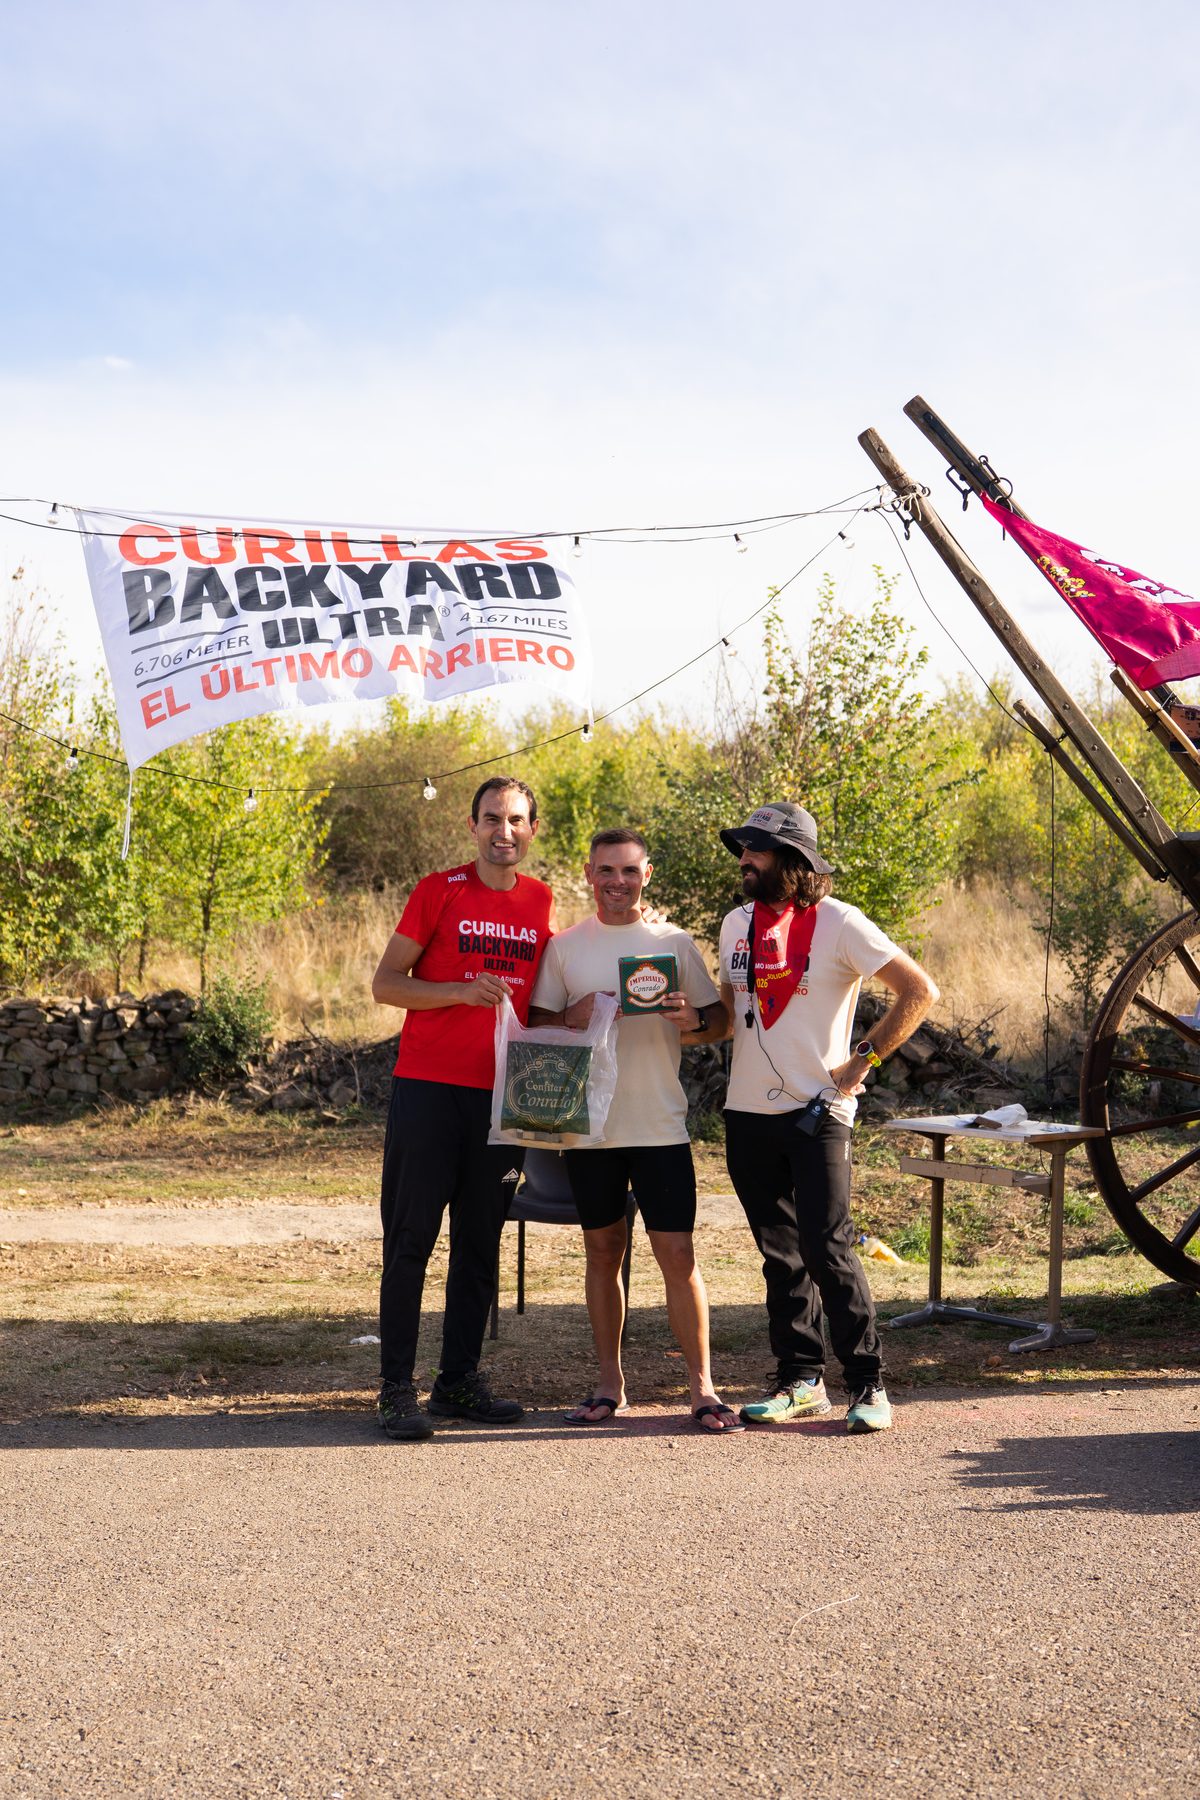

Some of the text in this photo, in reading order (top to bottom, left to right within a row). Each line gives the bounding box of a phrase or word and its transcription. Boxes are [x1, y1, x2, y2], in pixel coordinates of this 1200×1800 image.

[118, 524, 549, 566] CURILLAS
[121, 561, 562, 635] BACKYARD
[514, 616, 569, 631] MILES
[134, 635, 250, 677] 6.706 METER
[139, 637, 576, 730] EL ÚLTIMO ARRIERO
[458, 919, 537, 944] CURILLAS
[458, 935, 536, 962] BACKYARD
[464, 971, 475, 979] EL
[483, 957, 516, 973] ULTRA
[632, 983, 661, 993] Conrado
